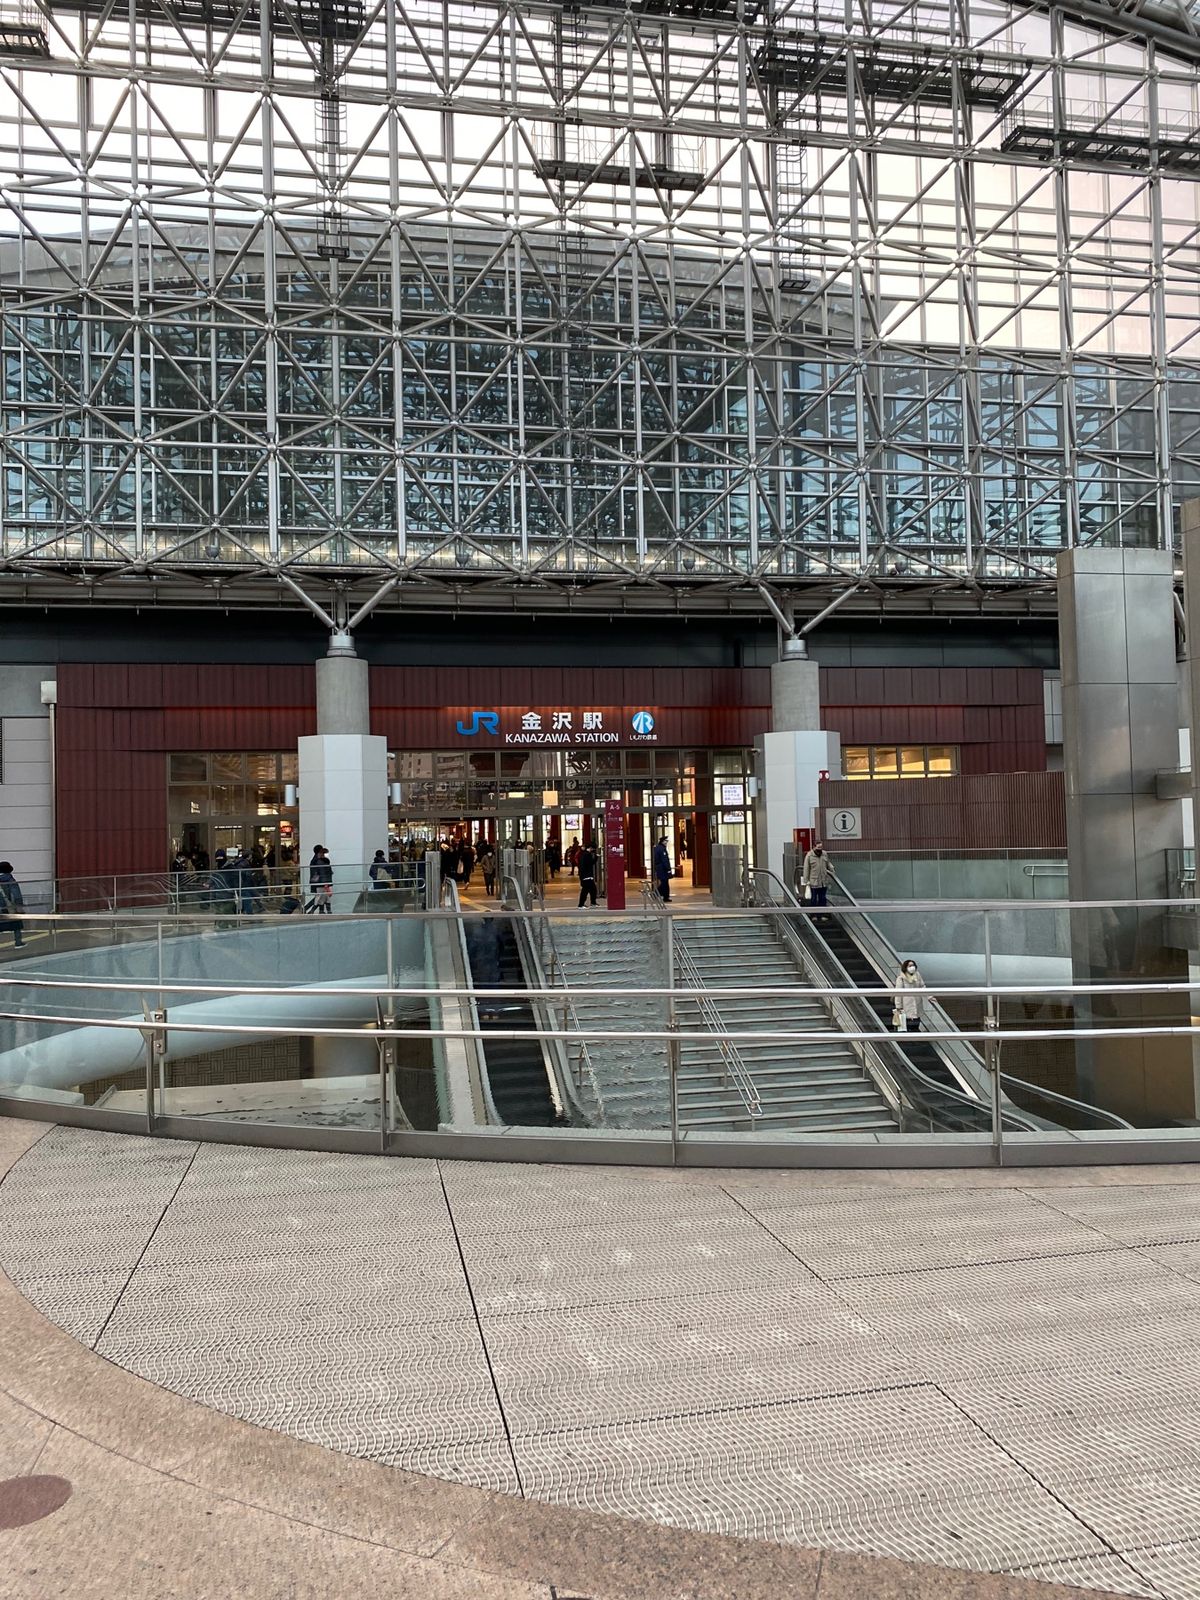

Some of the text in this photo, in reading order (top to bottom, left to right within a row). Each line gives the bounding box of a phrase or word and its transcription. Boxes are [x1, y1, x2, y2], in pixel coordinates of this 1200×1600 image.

[456, 711, 499, 735] JR
[521, 711, 603, 730] 金沢駅
[505, 733, 619, 743] KANAZAWA STATION
